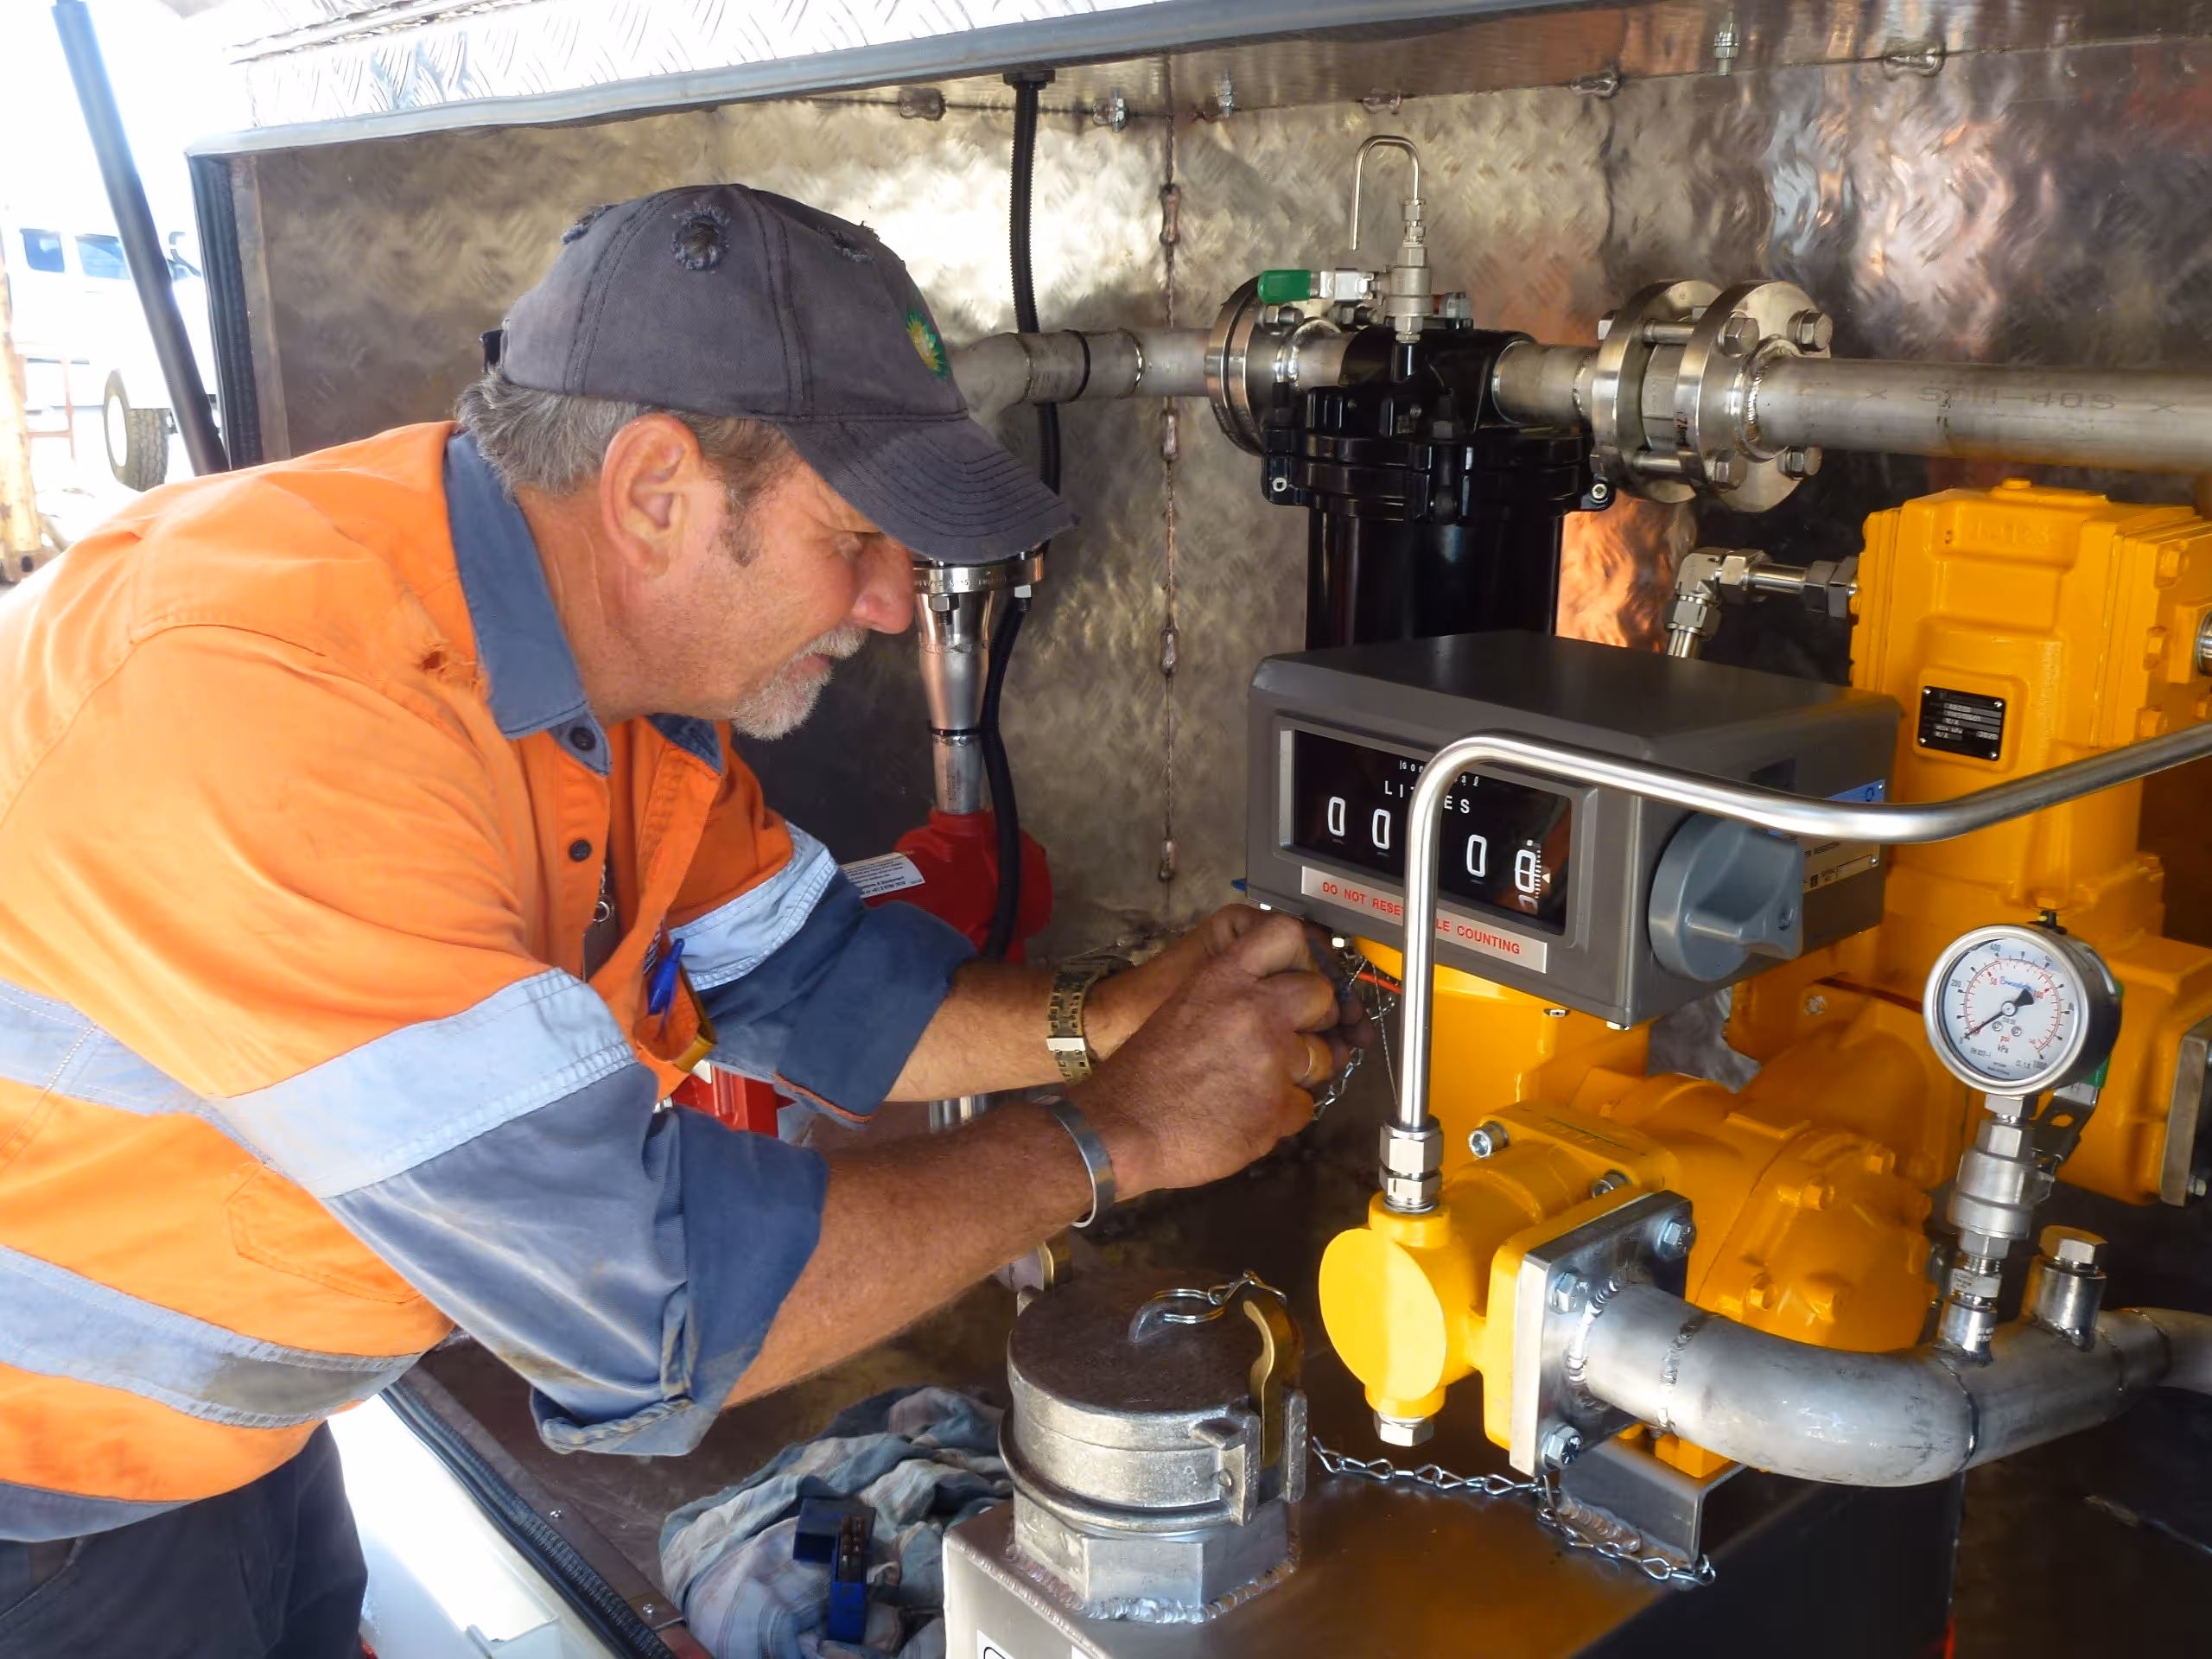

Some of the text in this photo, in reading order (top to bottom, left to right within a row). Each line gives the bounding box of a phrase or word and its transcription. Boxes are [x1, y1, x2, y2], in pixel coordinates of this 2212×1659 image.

[1322, 881, 1338, 896] DO
[1344, 889, 1367, 905] NOT
[1457, 925, 1521, 956] COUNTING
